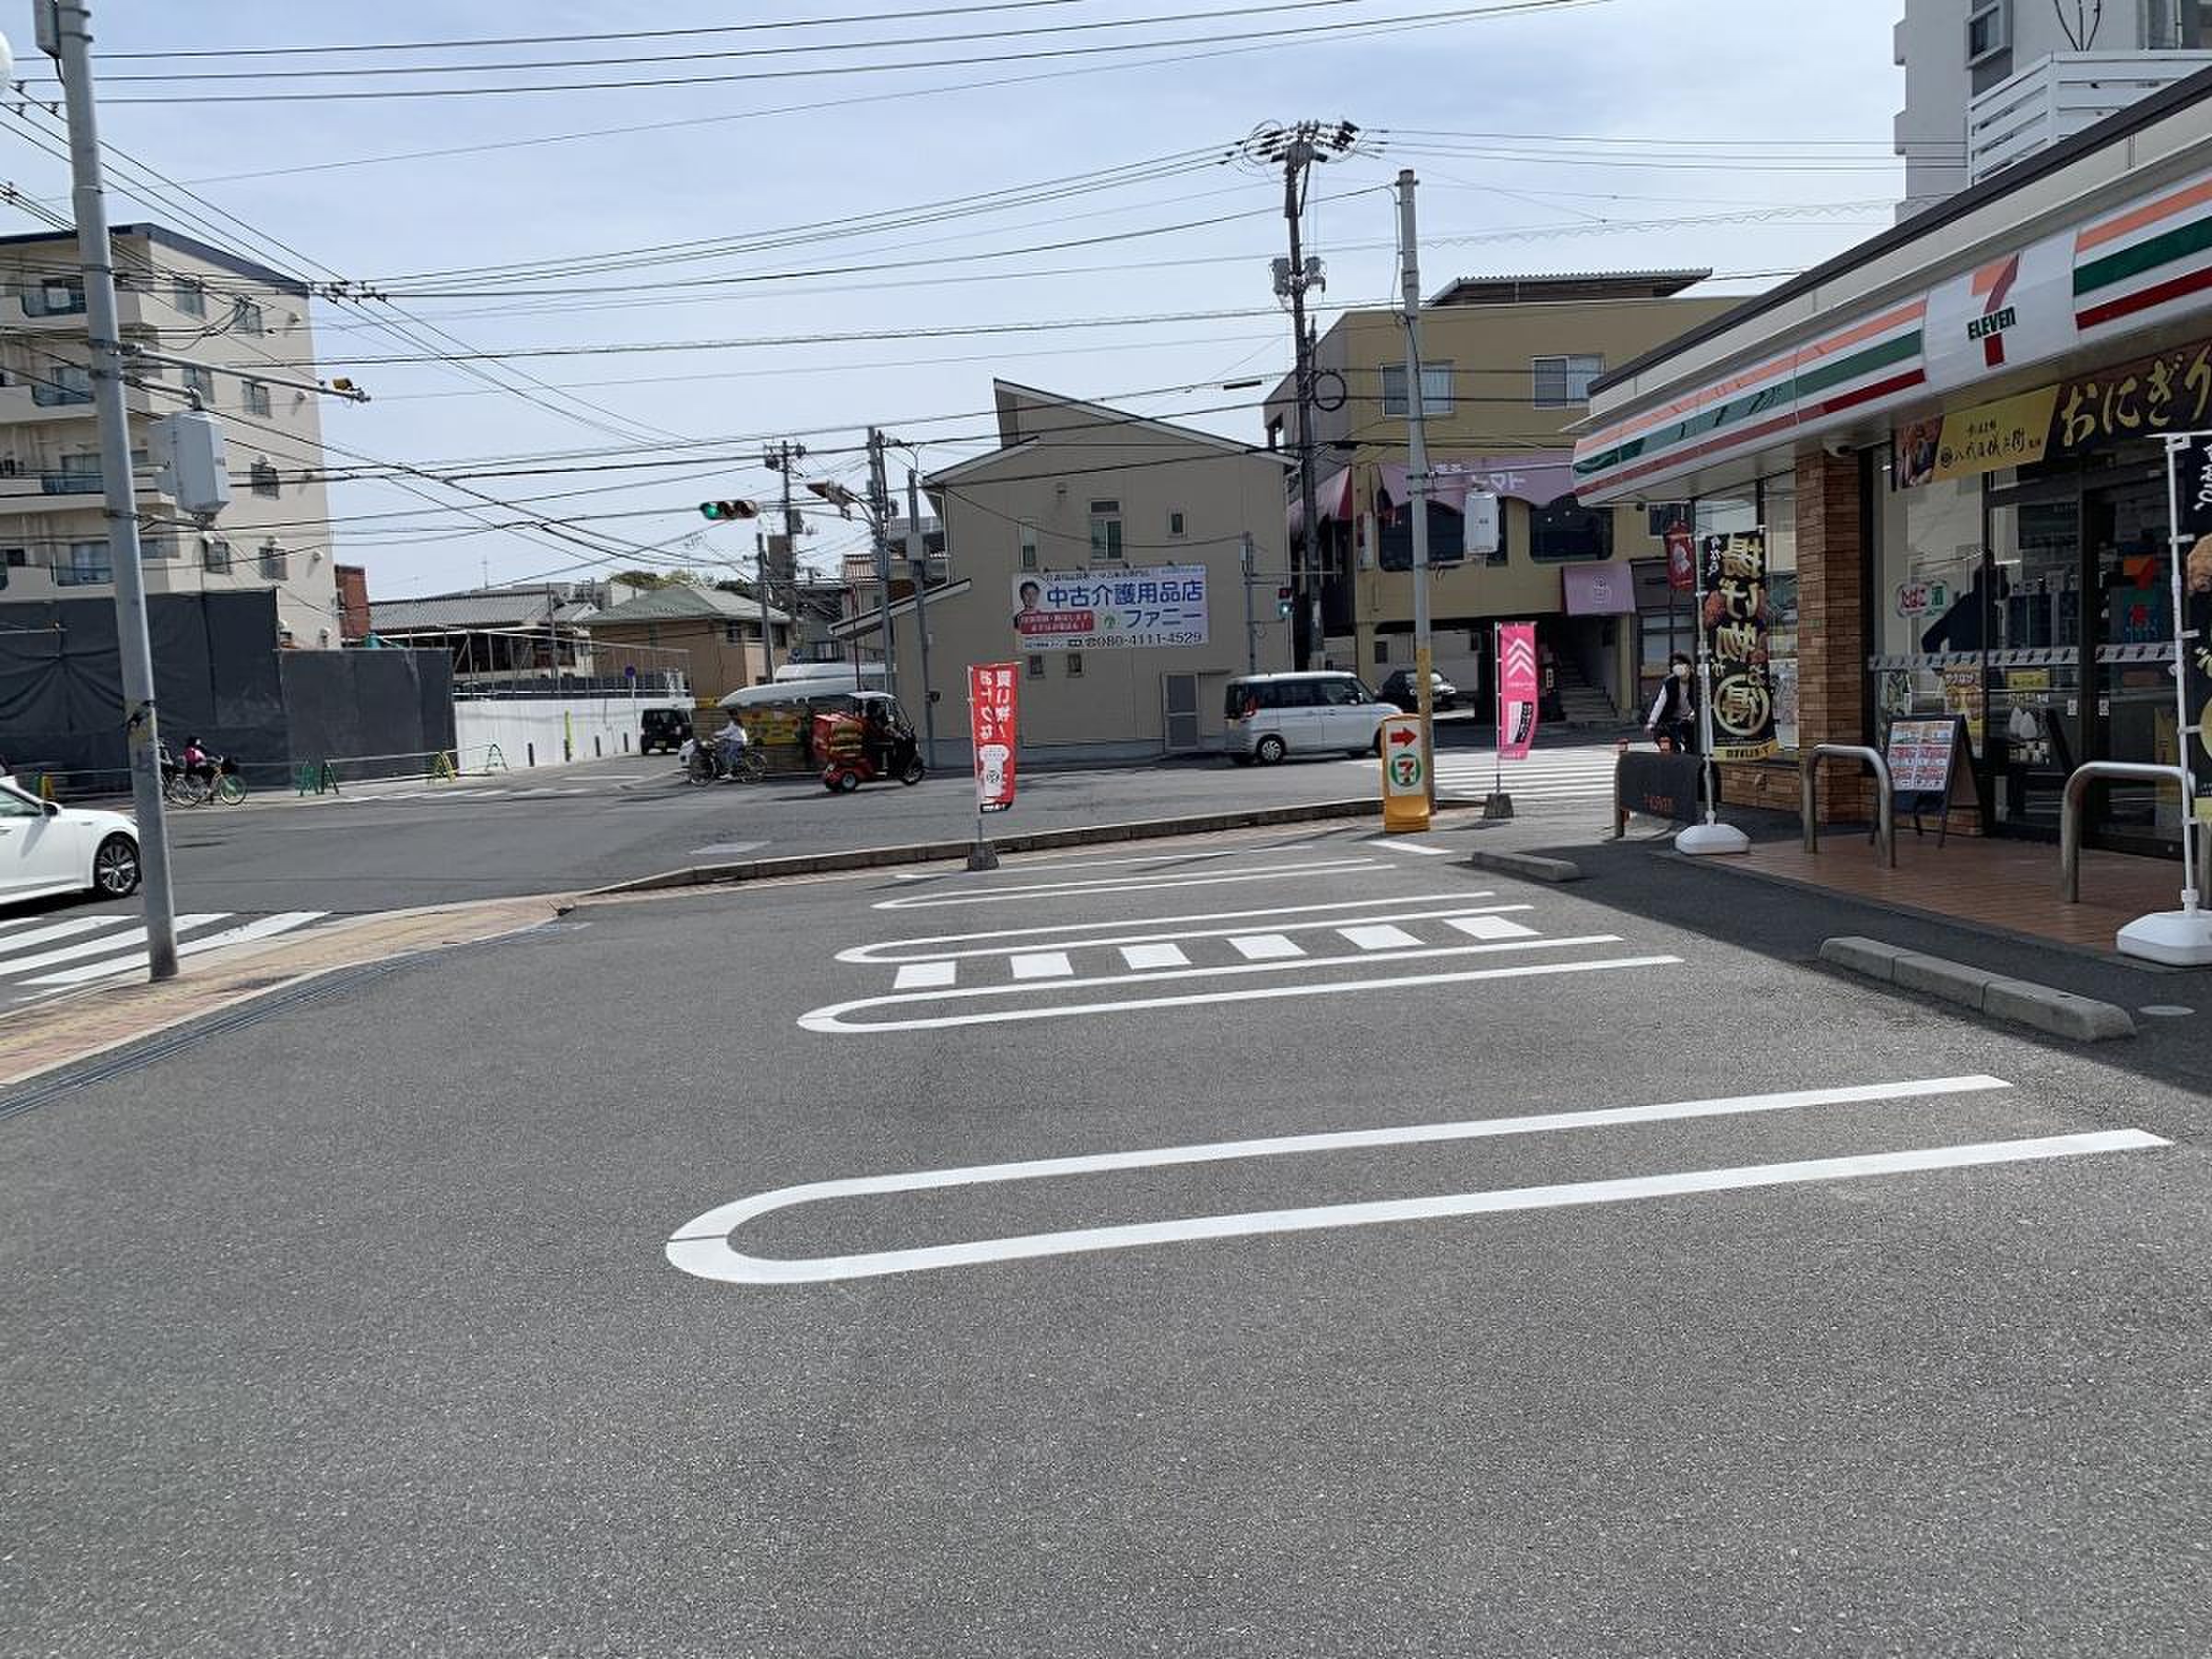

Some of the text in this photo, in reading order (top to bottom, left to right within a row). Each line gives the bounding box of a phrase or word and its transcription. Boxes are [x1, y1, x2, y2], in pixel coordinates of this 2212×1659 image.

[2063, 343, 2212, 446] おにぎり
[1046, 580, 1203, 608] 中古介護用品店
[1124, 608, 1203, 629] ファニー
